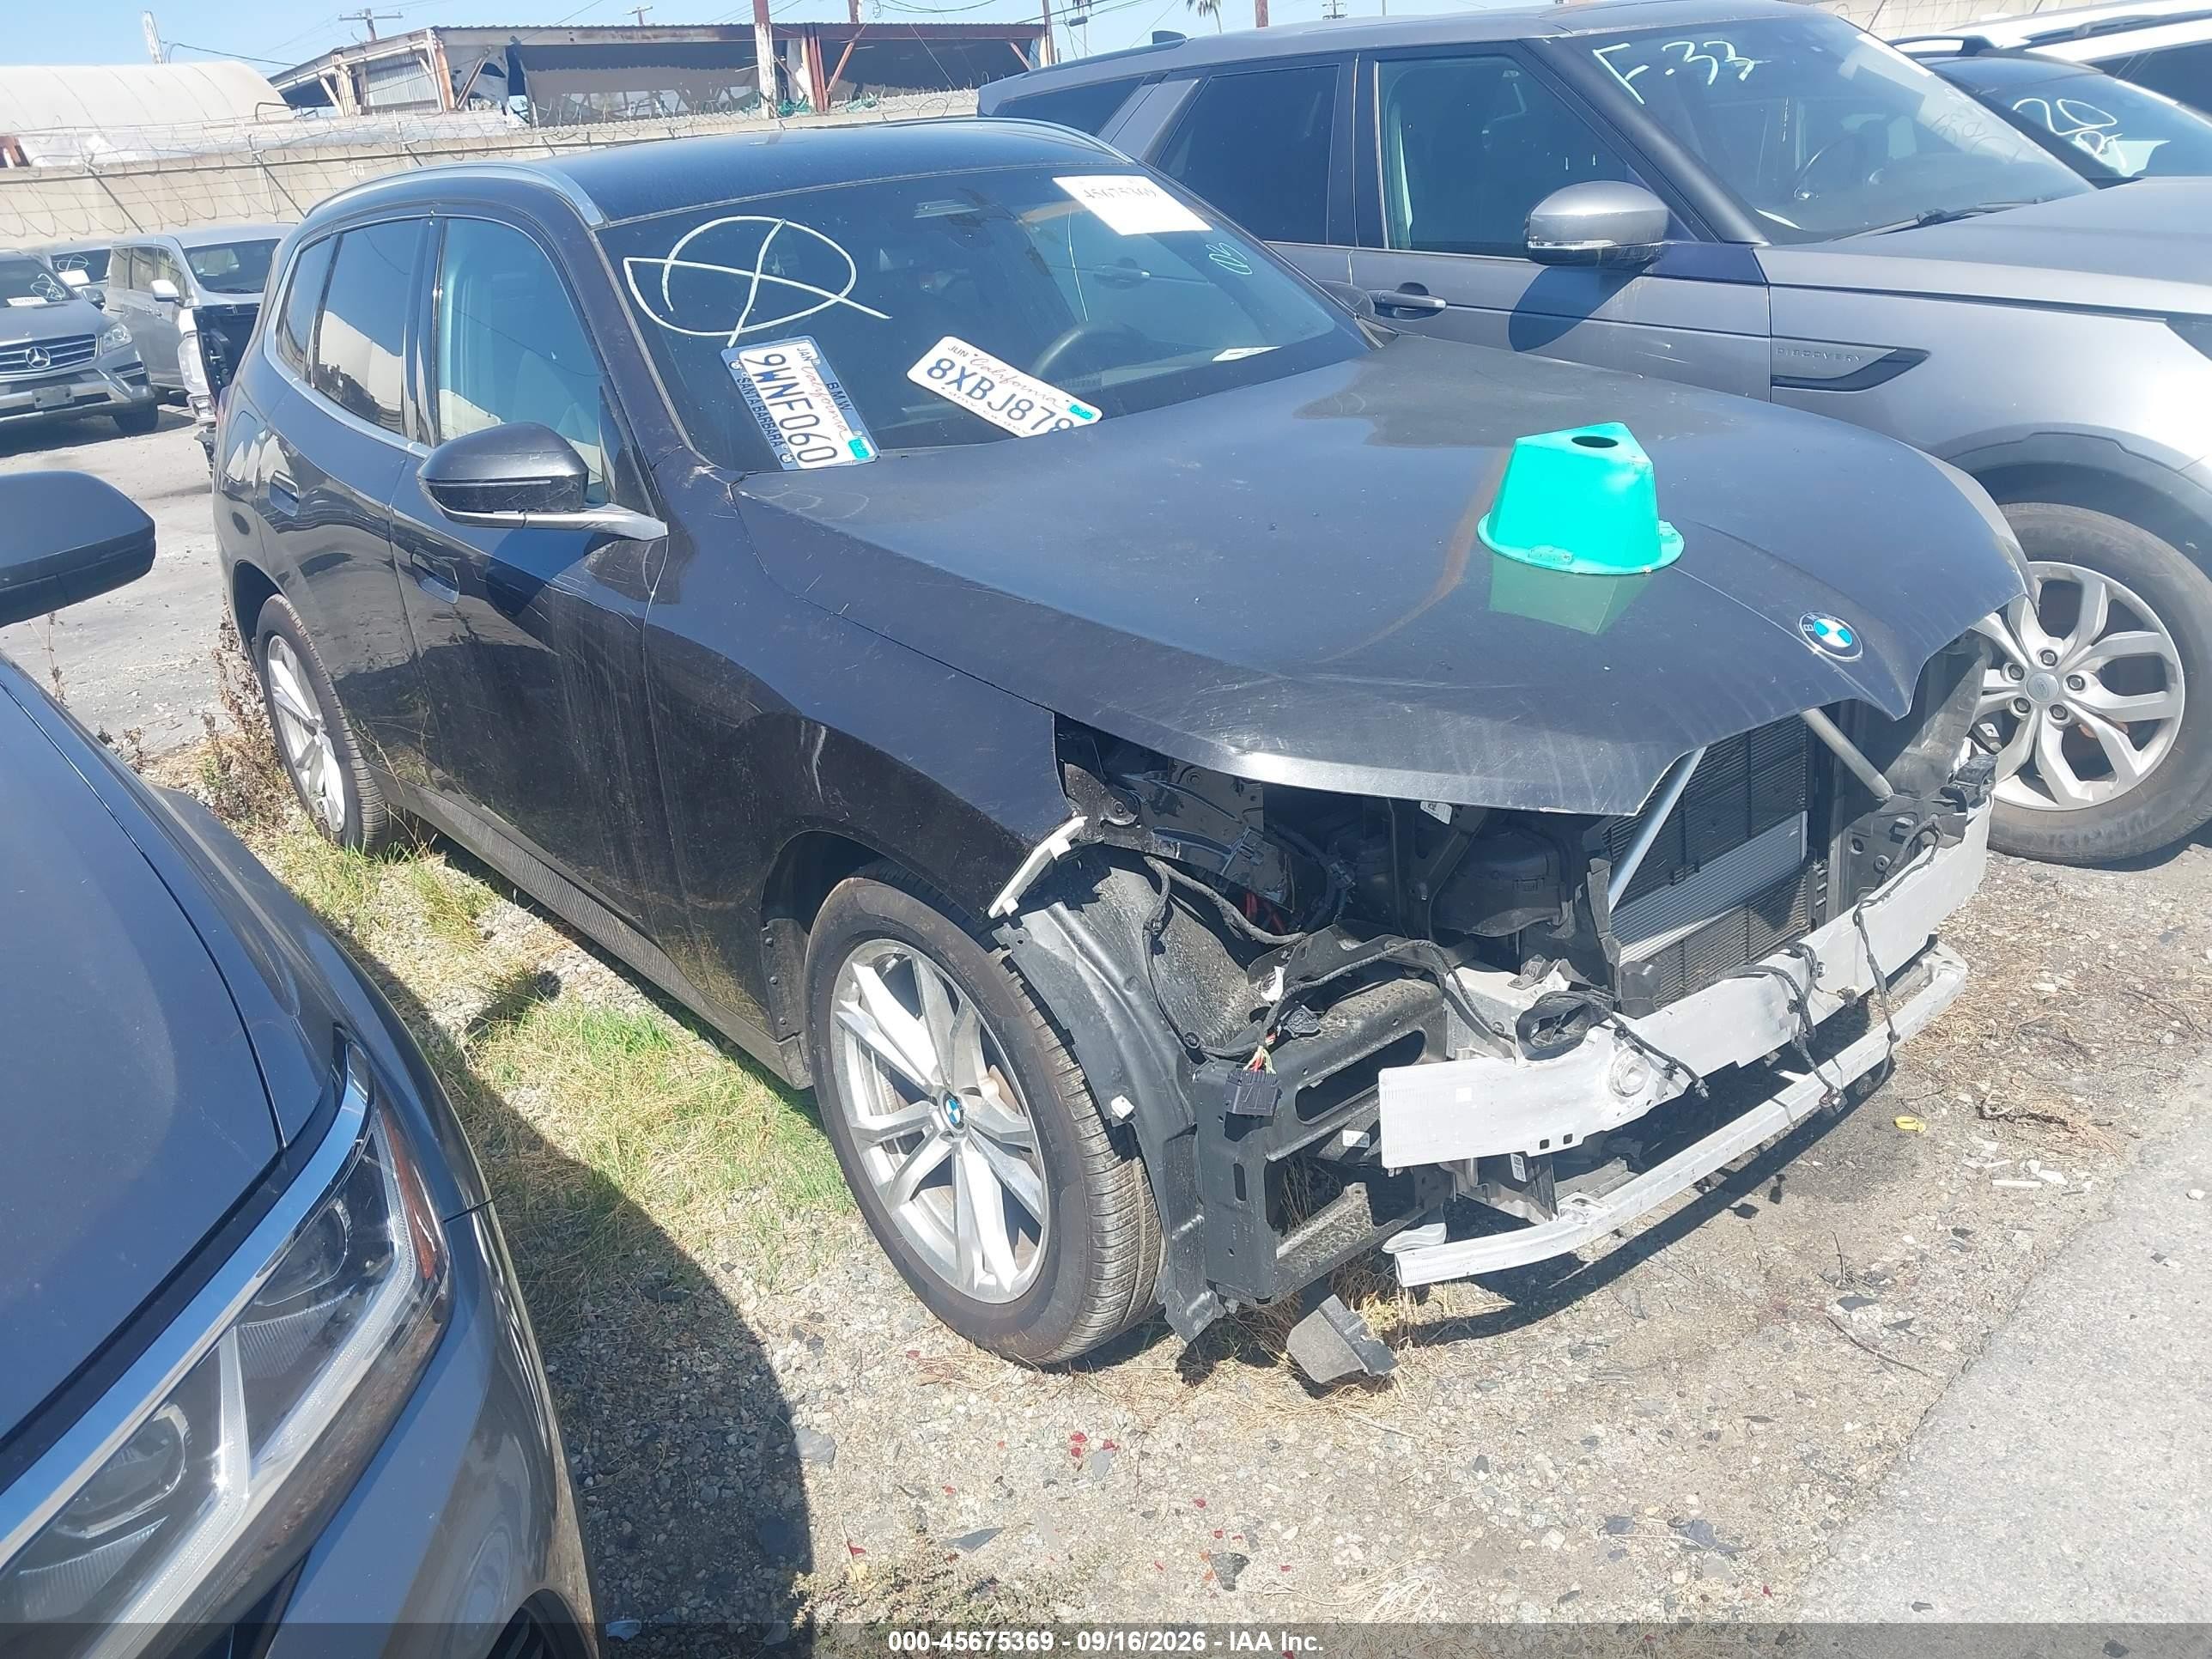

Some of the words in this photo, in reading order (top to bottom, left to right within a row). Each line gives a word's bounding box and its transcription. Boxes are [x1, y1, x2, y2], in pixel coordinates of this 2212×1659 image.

[797, 347, 813, 362] JAN
[947, 345, 969, 358] JUN
[827, 381, 852, 410] BMW
[969, 357, 1066, 410] California
[736, 376, 761, 404] SANTA
[753, 404, 786, 447] BARBARA
[744, 353, 838, 463] 9WNF060
